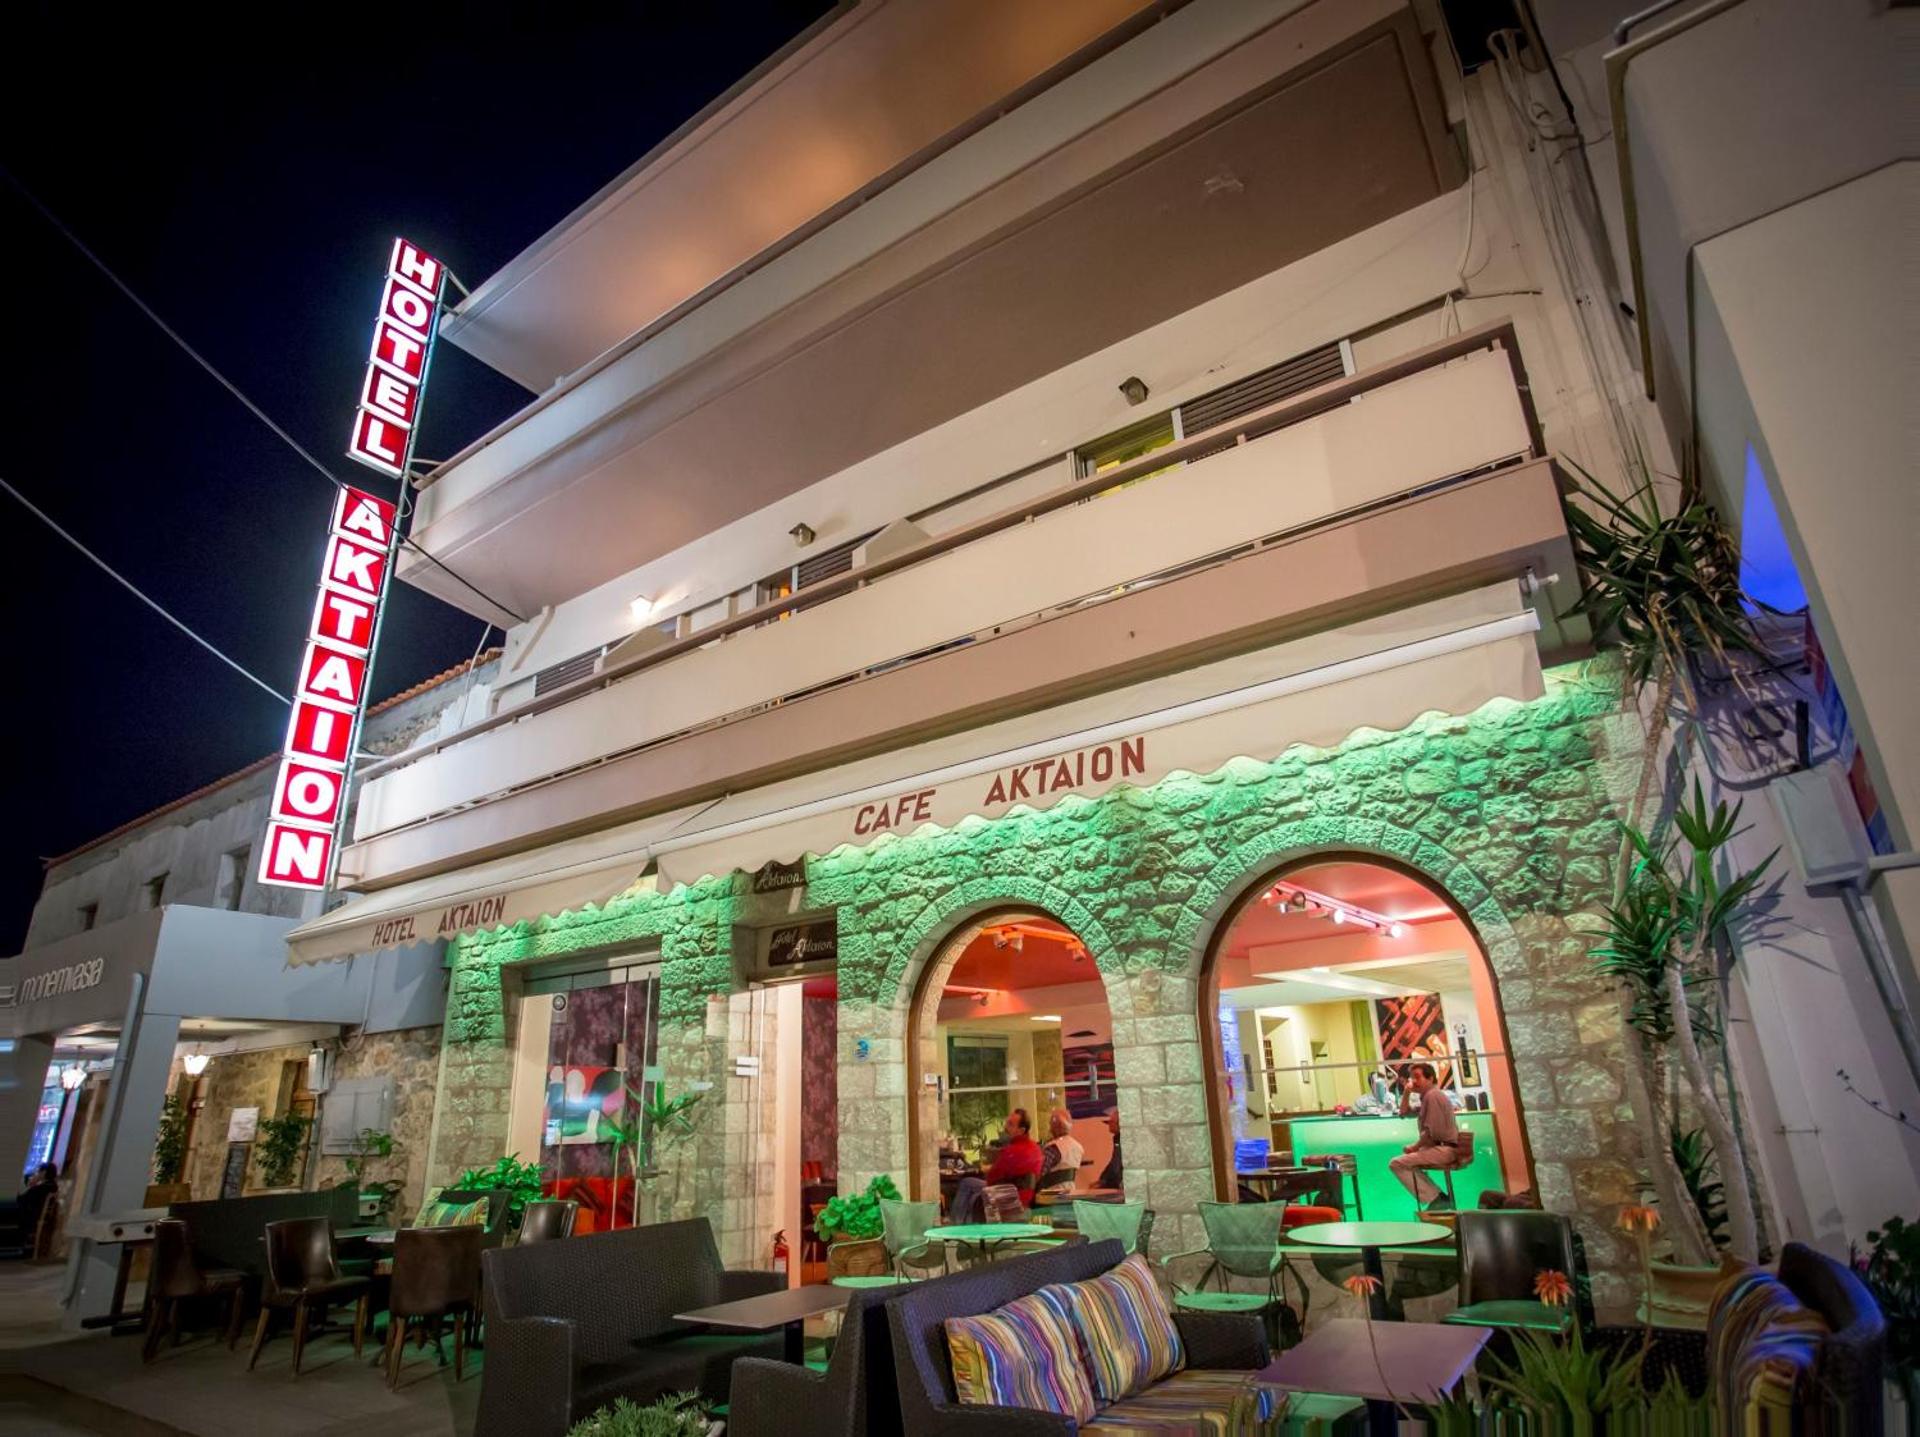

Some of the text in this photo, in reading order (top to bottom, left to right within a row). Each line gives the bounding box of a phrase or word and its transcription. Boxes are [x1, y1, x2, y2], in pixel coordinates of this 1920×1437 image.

[366, 245, 437, 462] HOTEL
[272, 497, 386, 880] AKTAION
[854, 736, 1146, 836] CAFE AKTAION
[371, 895, 506, 948] HOTEL AKTAION
